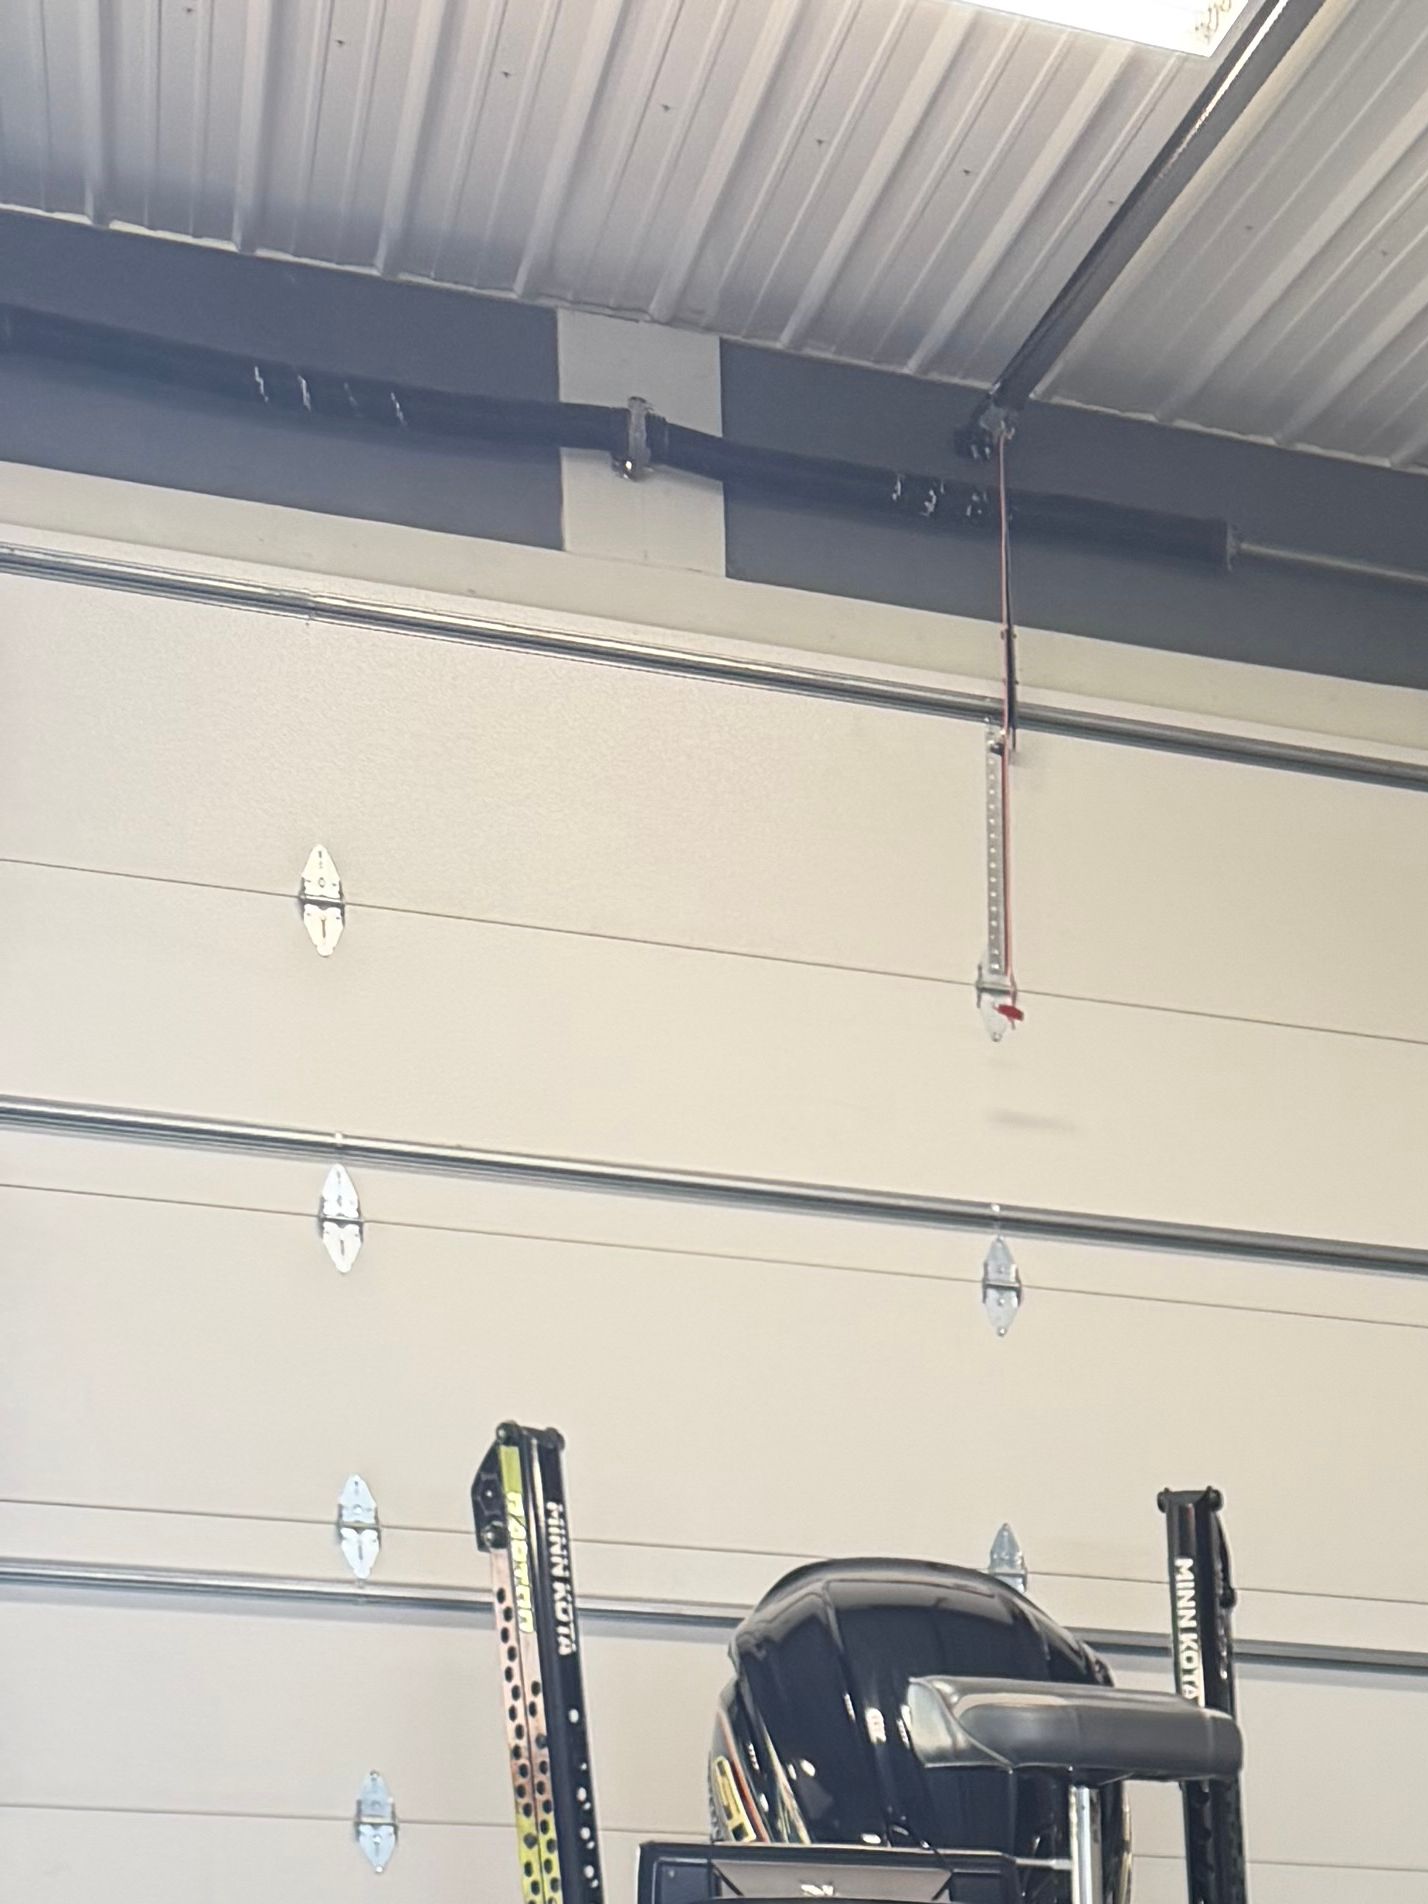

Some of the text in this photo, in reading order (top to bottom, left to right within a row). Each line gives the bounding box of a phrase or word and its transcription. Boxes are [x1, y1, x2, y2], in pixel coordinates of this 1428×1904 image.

[546, 1500, 578, 1657] MINN KOTA
[1174, 1558, 1204, 1701] MINN KOTA
